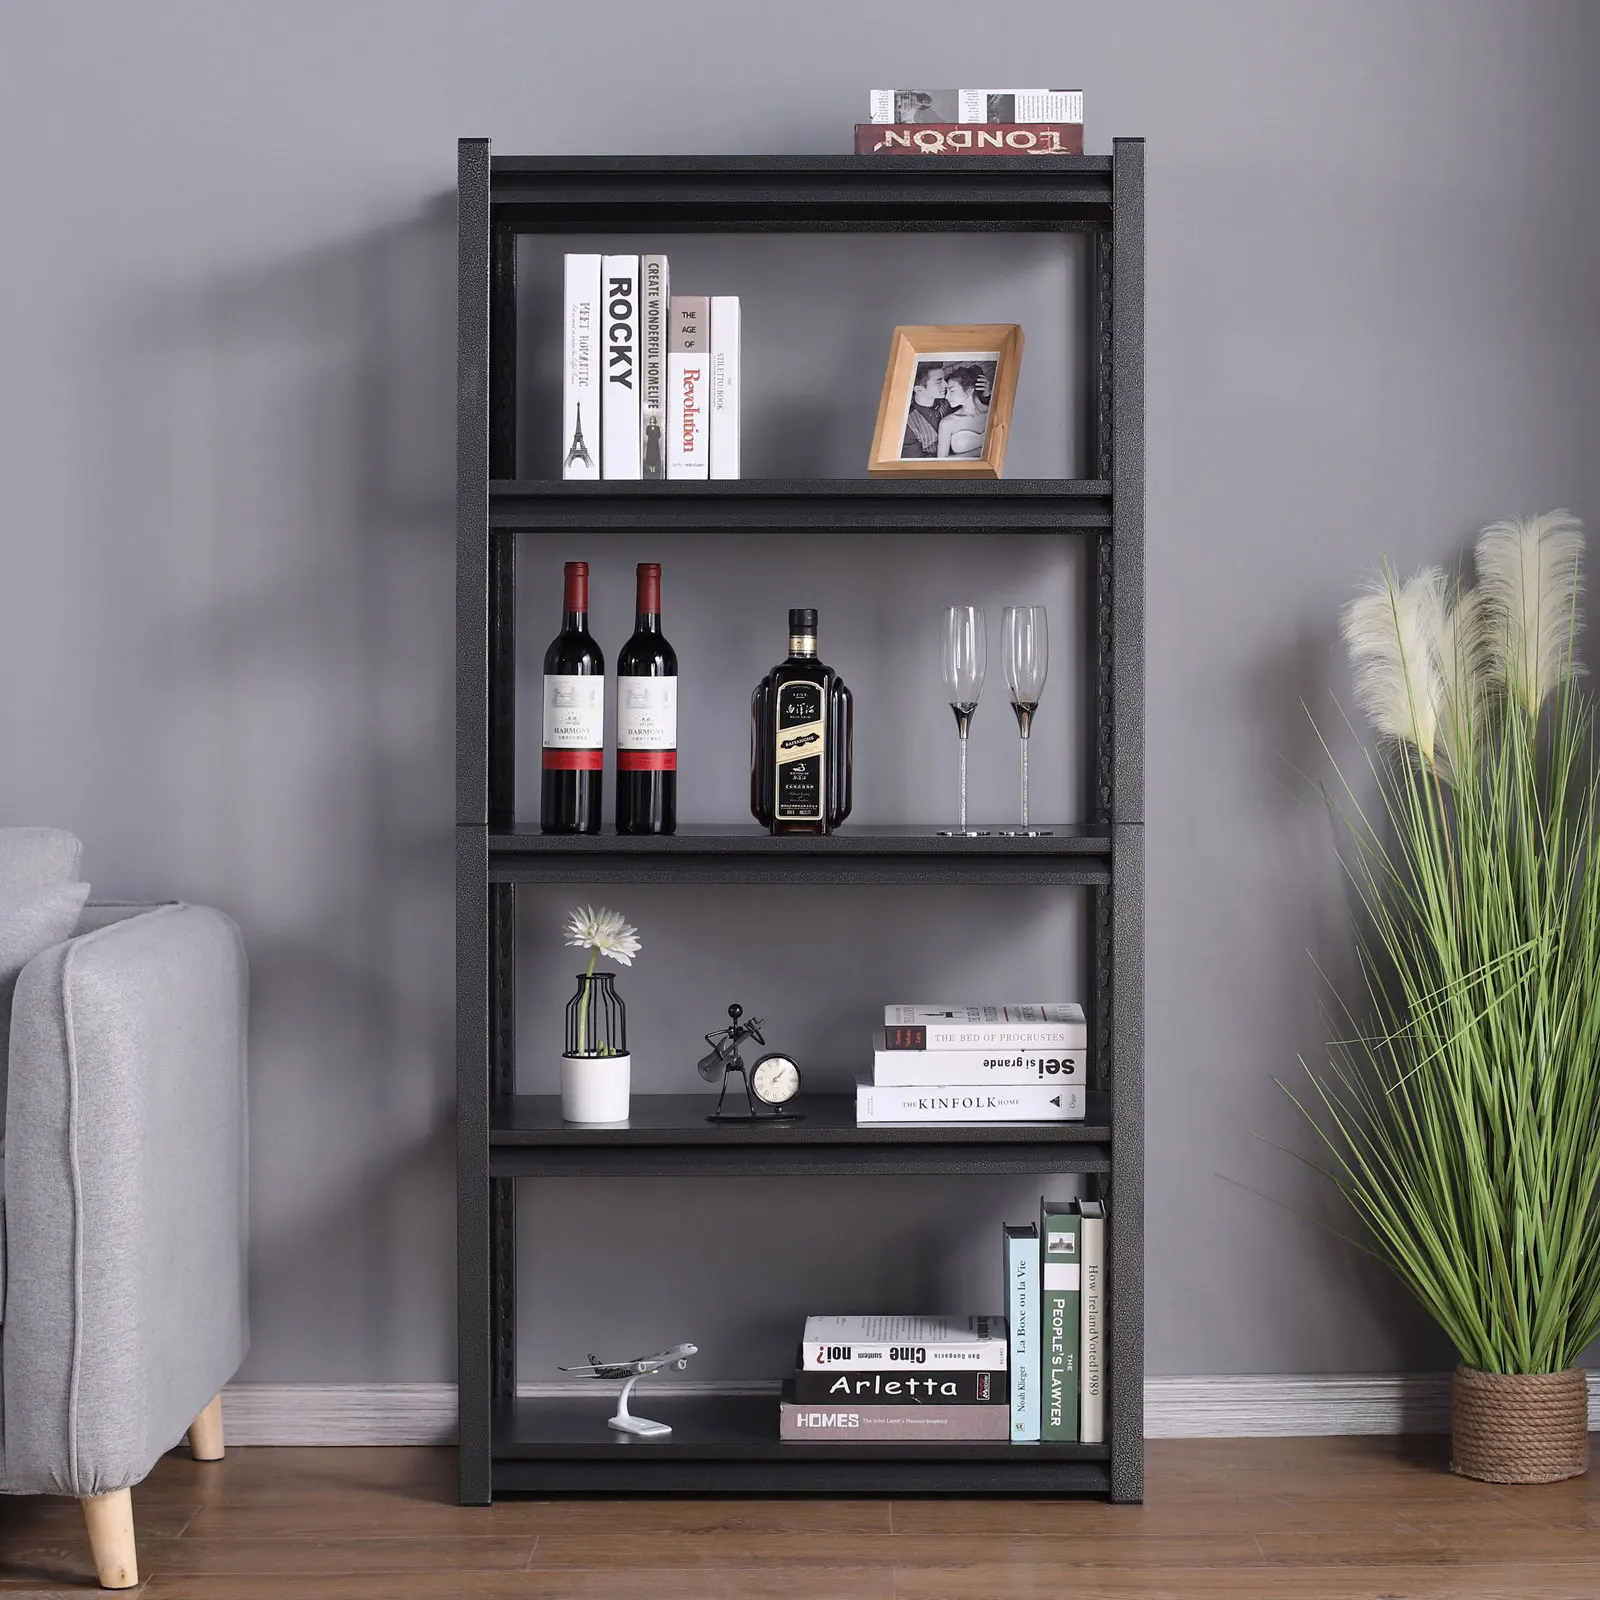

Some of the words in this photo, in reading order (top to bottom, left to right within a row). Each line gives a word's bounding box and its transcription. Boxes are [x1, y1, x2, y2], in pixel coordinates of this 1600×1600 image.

[875, 127, 1071, 154] LONDON
[648, 262, 659, 297] CREATE
[579, 302, 591, 330] MEET
[681, 311, 696, 319] THE
[608, 277, 633, 390] ROCKY
[648, 299, 659, 359] WONDERFUL
[681, 326, 697, 334] AGE
[684, 340, 695, 348] OF
[578, 335, 590, 388] ROMANTIC
[716, 352, 725, 387] STILETTO
[648, 362, 659, 409] HOMELIFE
[716, 389, 725, 411] BOOK
[683, 368, 701, 453] Revolution
[934, 1034, 955, 1042] THE
[959, 1034, 981, 1042] BED
[983, 1033, 996, 1042] OF
[999, 1033, 1065, 1042] PROCRUSTES
[983, 1057, 1023, 1069] grande
[1026, 1058, 1036, 1069] si
[1038, 1058, 1075, 1079] sei
[918, 1096, 998, 1110] KINFOLK
[1017, 1260, 1026, 1278] Vie
[1088, 1264, 1099, 1291] How
[1017, 1280, 1026, 1291] la
[1018, 1293, 1026, 1307] ou
[1017, 1310, 1026, 1336] Boxe
[816, 1346, 852, 1364] noi?
[857, 1352, 883, 1360] suntem
[889, 1347, 927, 1365] Cine
[1017, 1340, 1026, 1354] La
[829, 1375, 958, 1396] Arletta
[1017, 1366, 1027, 1391] Klieger
[1017, 1392, 1026, 1412] Noah
[1050, 1368, 1064, 1426] LAWYER
[796, 1413, 859, 1428] HOMES
